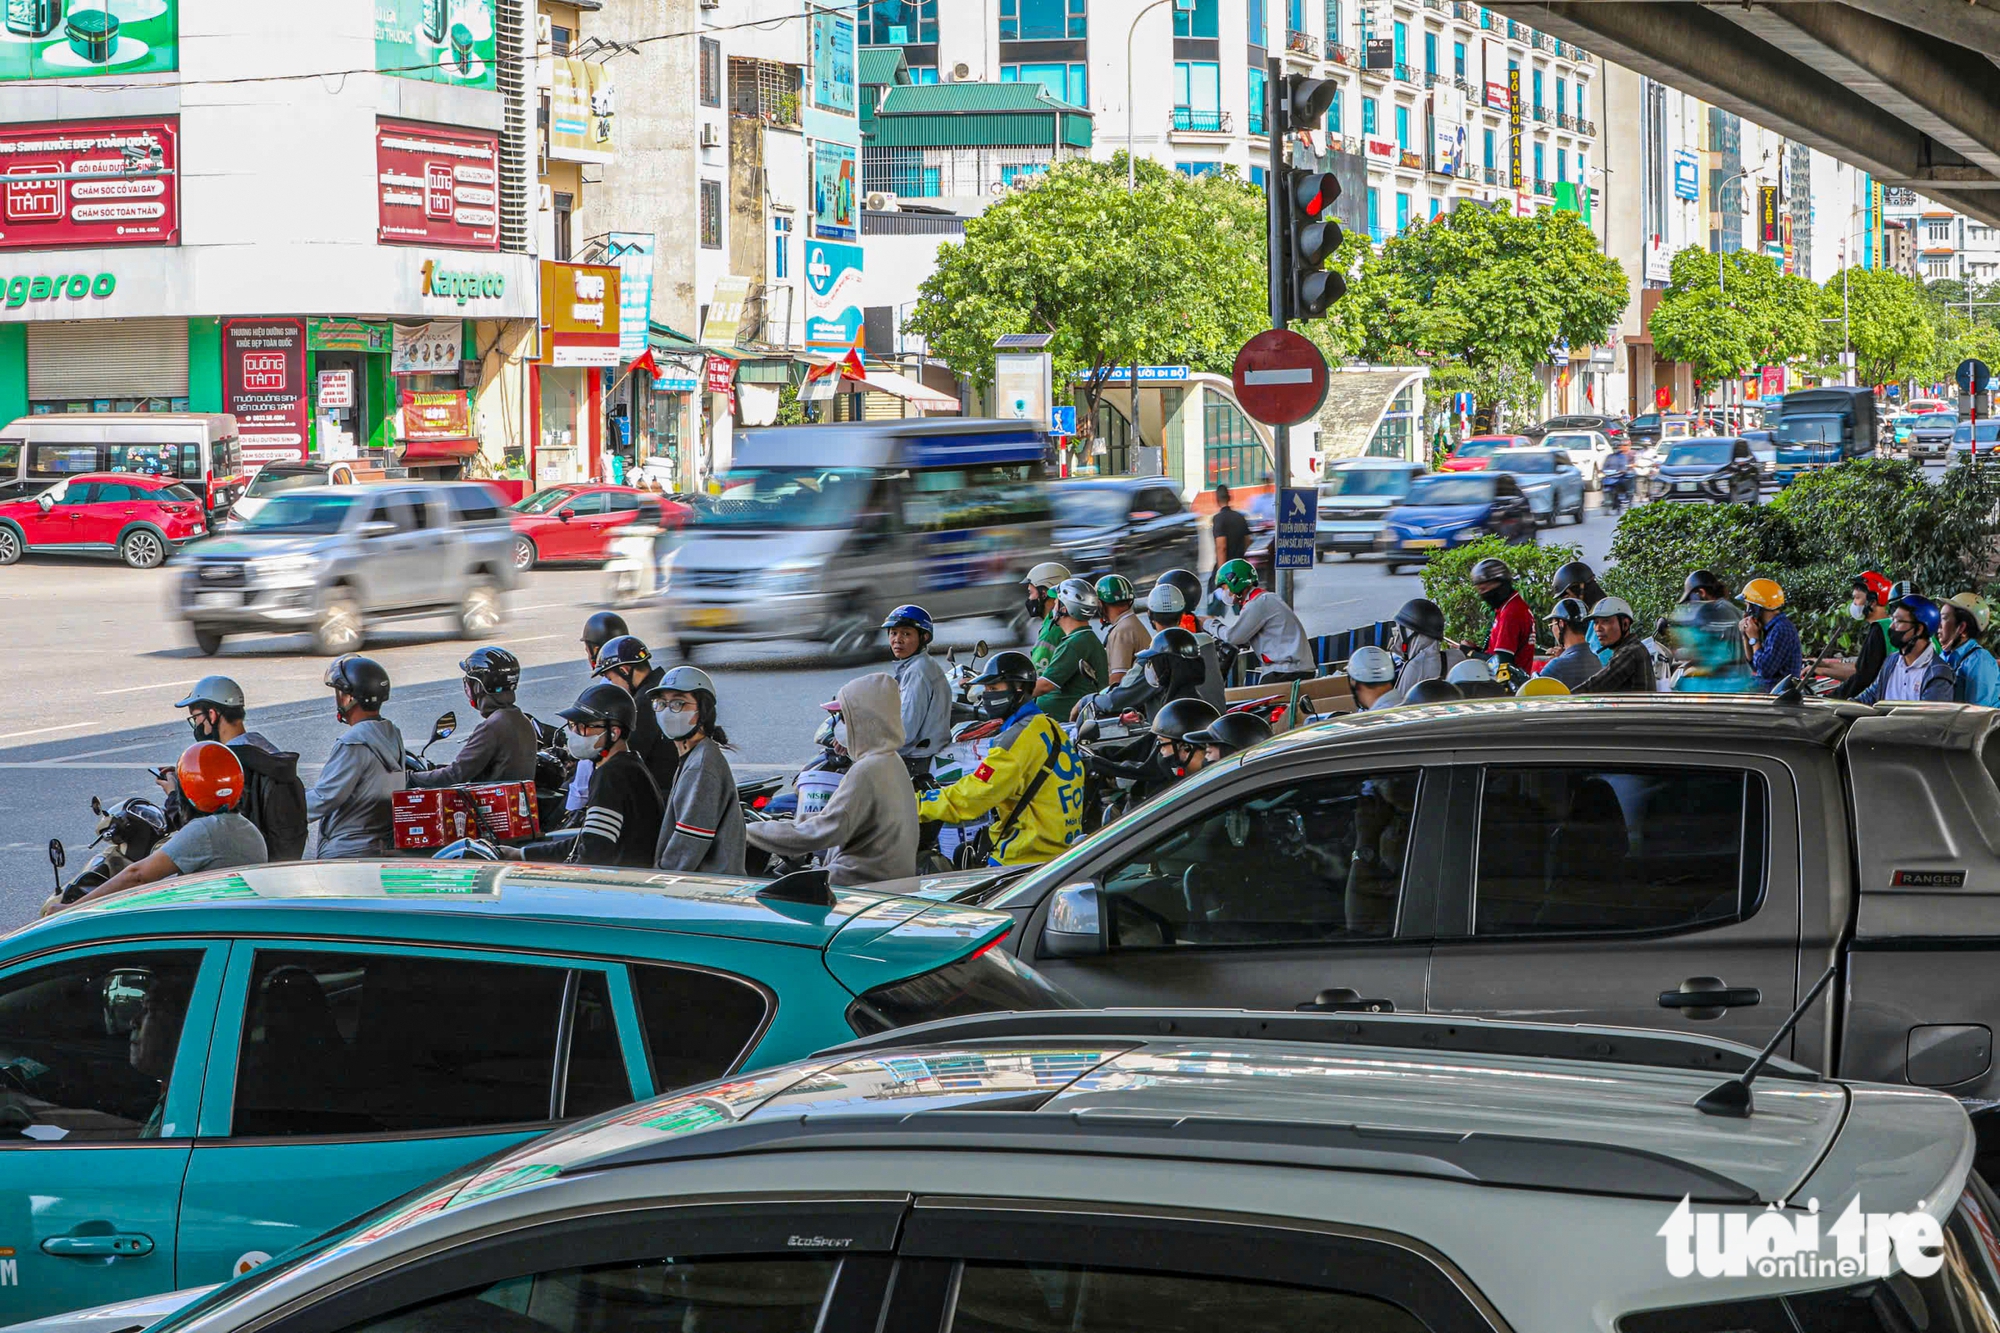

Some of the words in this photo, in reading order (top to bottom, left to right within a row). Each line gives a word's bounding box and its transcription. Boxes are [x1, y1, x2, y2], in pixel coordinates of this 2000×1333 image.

[17, 139, 43, 152] SINH
[73, 137, 96, 152] ĐẸP
[95, 133, 126, 149] TOÀN
[126, 131, 158, 147] QUỐC
[1513, 159, 1521, 186] ANH
[128, 185, 141, 193] VAI
[77, 206, 99, 218] CHĂM
[100, 206, 116, 217] SÓC
[117, 204, 136, 216] TOÀN
[230, 327, 252, 337] THƯƠNG
[252, 326, 266, 337] HIỆU
[266, 326, 284, 336] DƯỠNG
[284, 327, 298, 336] SINH
[236, 337, 251, 348] KHỎE
[251, 338, 262, 349] ĐẸP
[263, 337, 278, 348] TOÀN
[278, 336, 293, 347] QUỐC
[710, 363, 717, 371] XE
[717, 362, 730, 372] MÁY
[709, 374, 717, 382] XE
[1157, 369, 1168, 378] ĐI
[1170, 367, 1185, 379] BỘ
[280, 394, 298, 402] SINH
[276, 402, 295, 411] TÂM
[1291, 554, 1311, 565] CAMERA
[1903, 874, 1960, 883] RANGER
